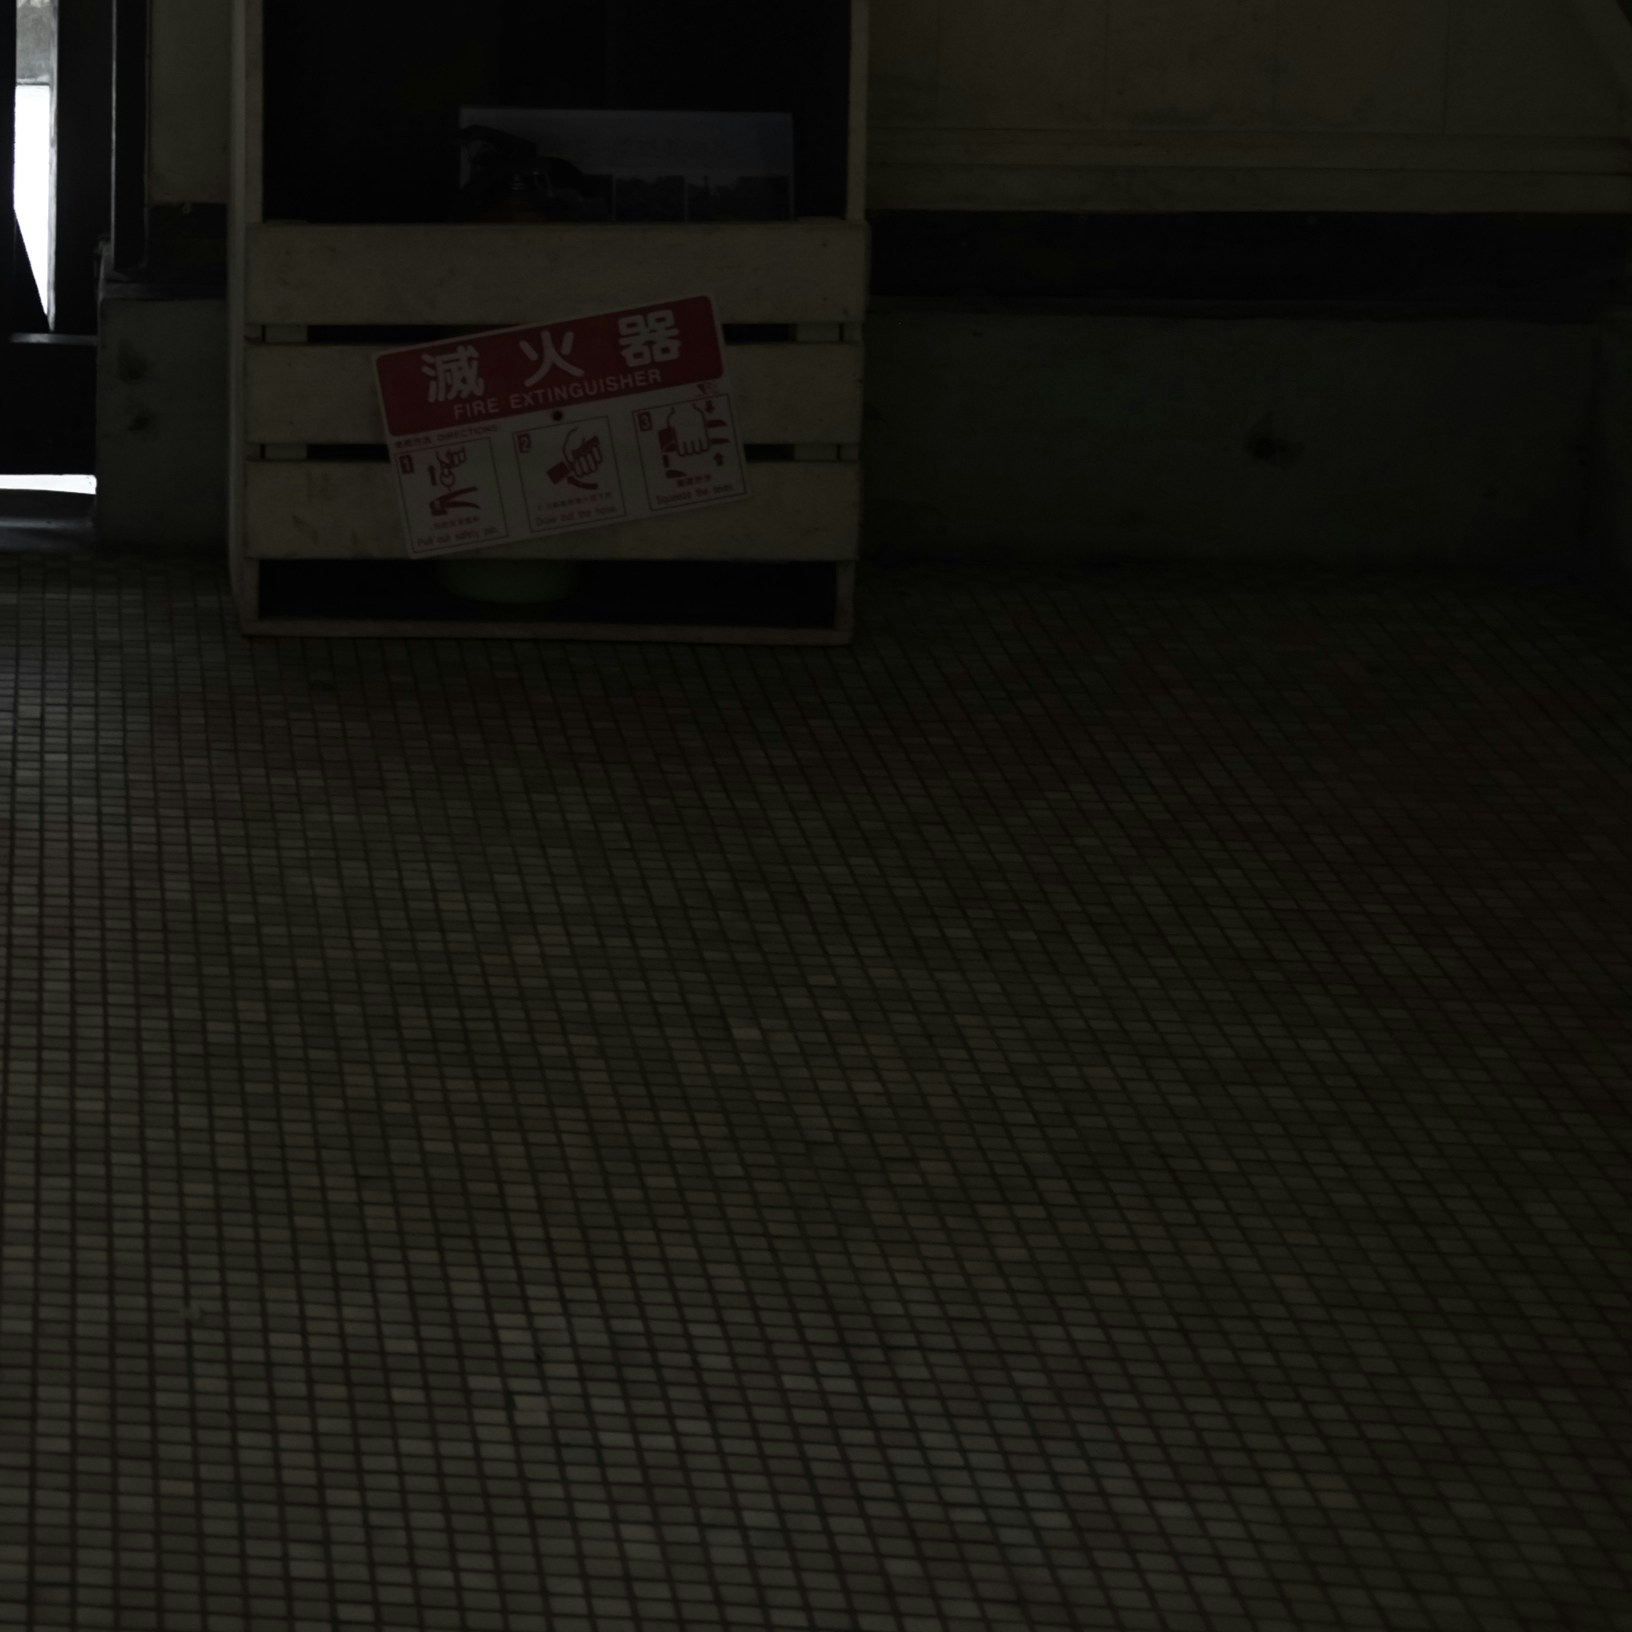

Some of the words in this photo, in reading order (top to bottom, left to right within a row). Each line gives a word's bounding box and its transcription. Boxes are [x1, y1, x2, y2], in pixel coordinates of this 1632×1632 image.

[421, 308, 681, 404] 滅火器
[453, 396, 500, 421] FIRE
[510, 368, 663, 410] EXTINGUISHER
